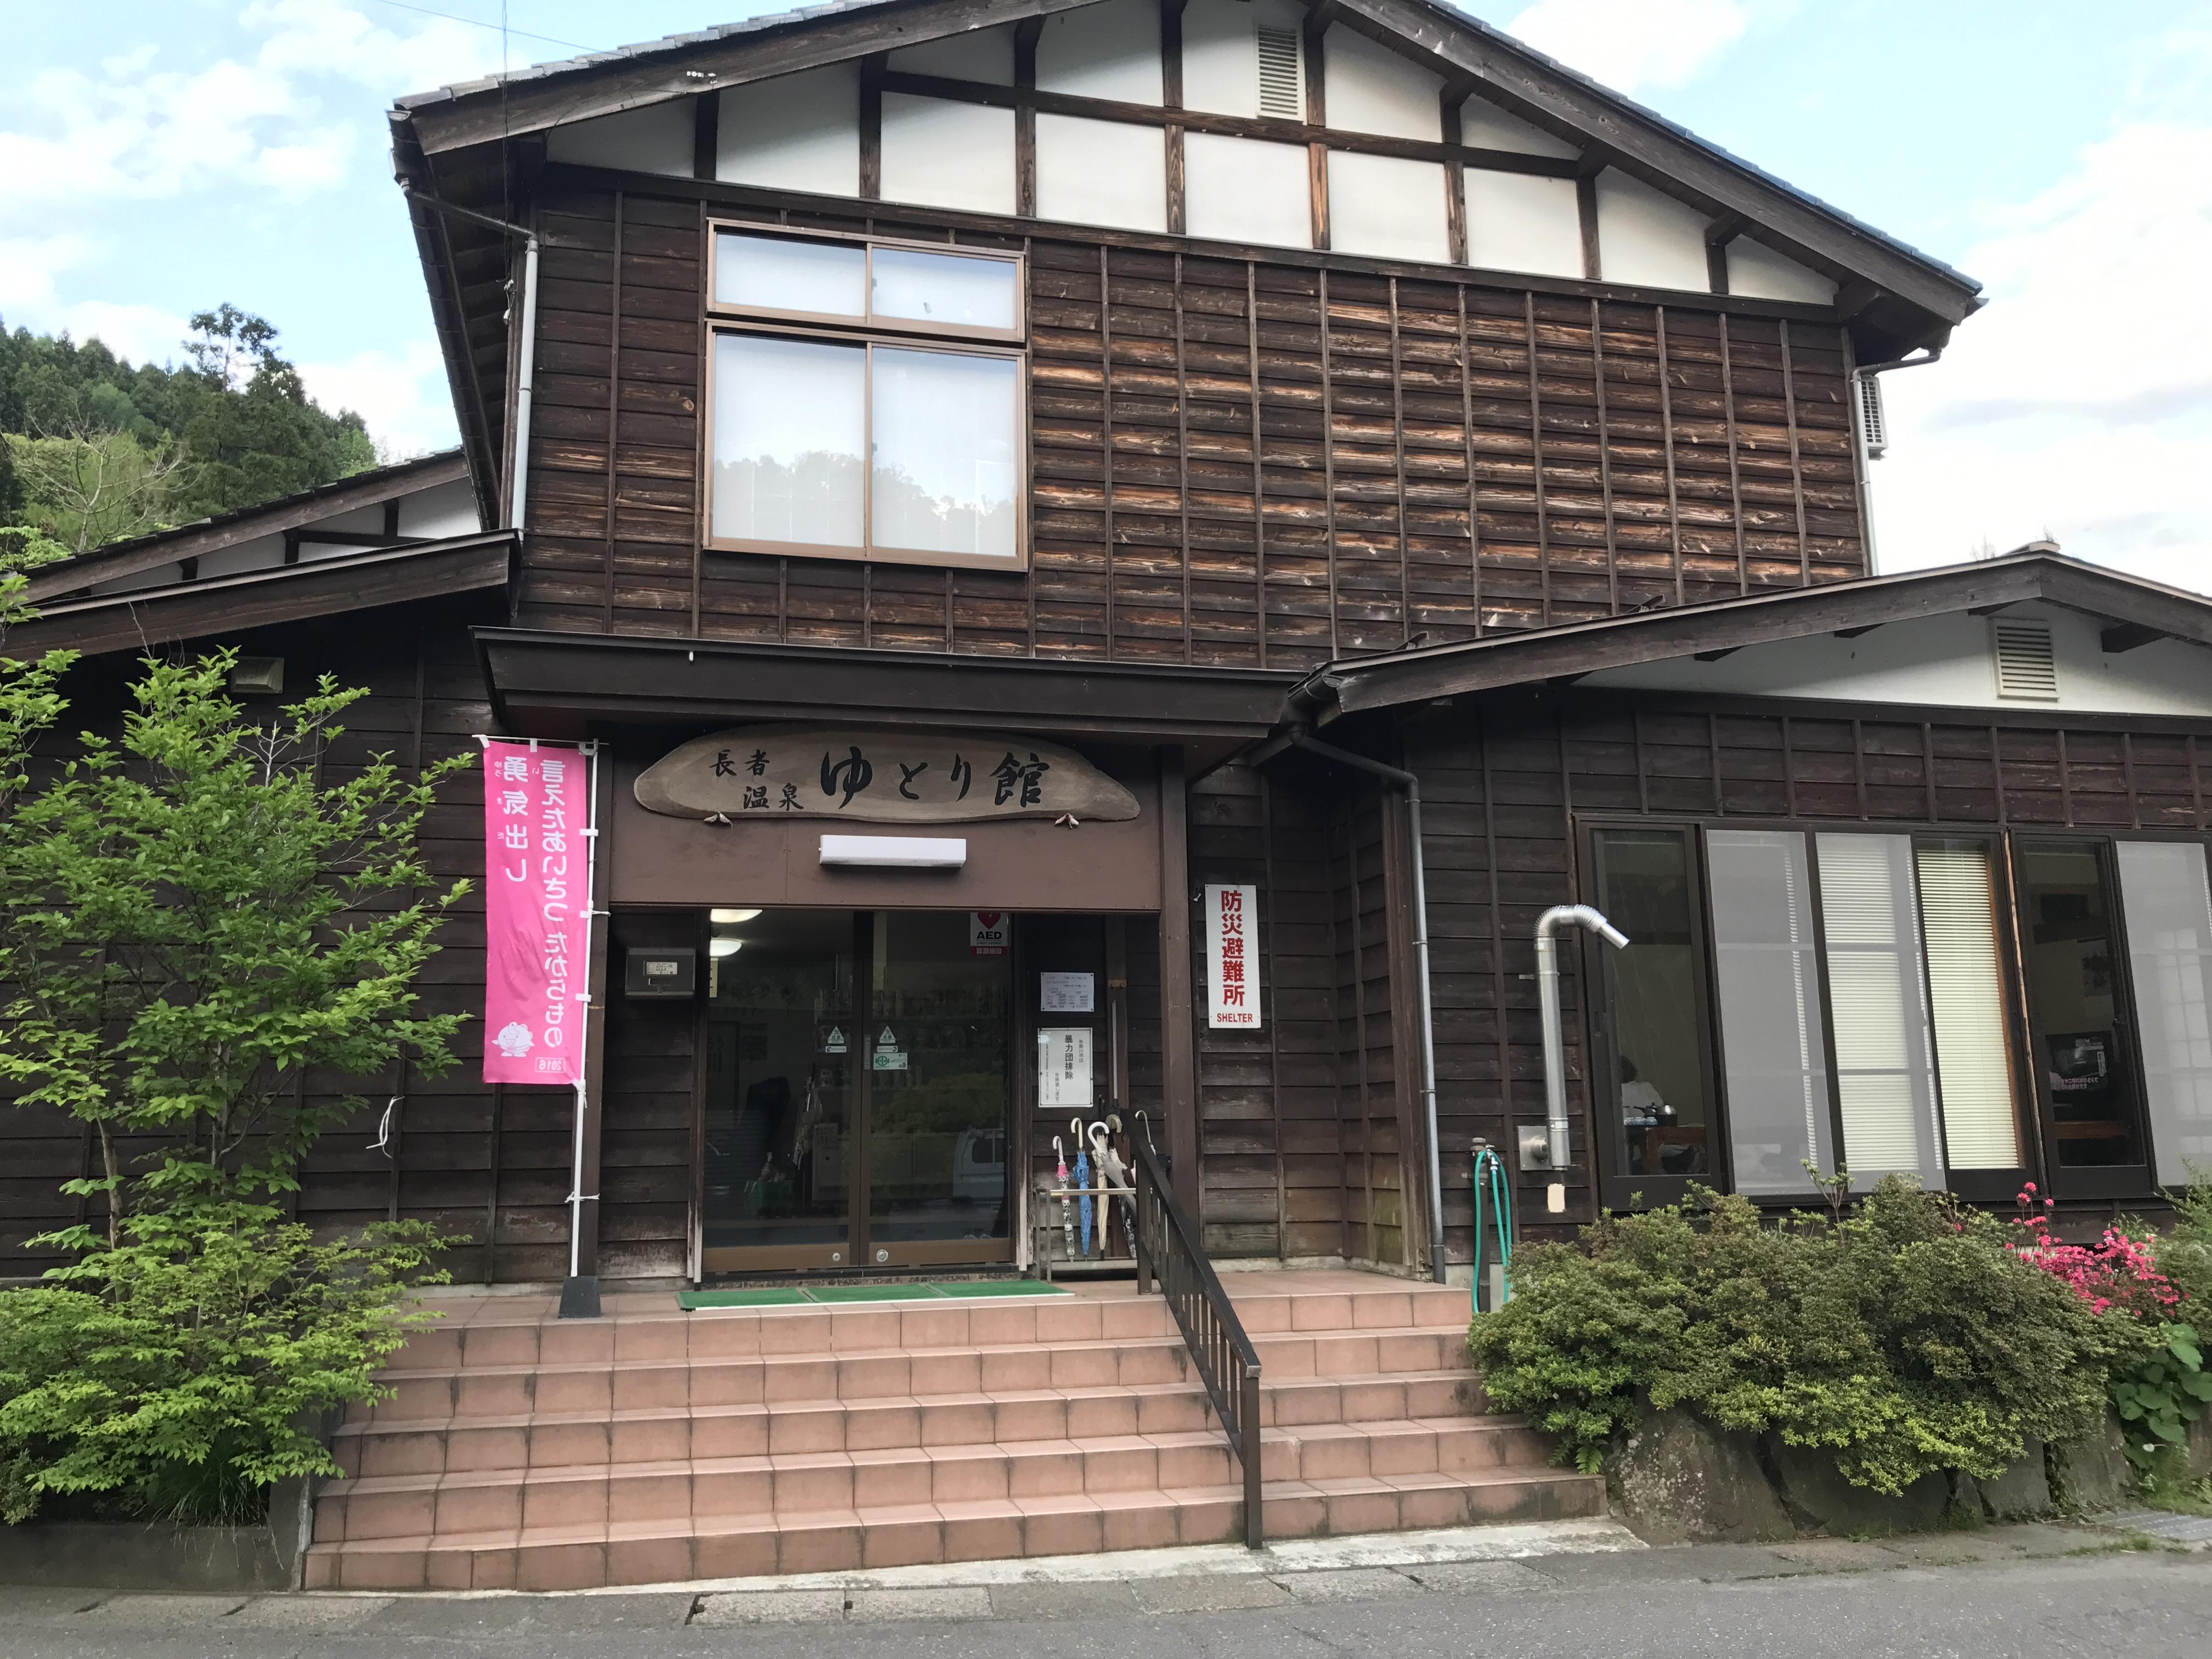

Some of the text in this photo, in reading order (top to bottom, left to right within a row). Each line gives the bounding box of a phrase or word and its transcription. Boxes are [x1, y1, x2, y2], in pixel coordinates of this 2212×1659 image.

[709, 749, 770, 777] 長者
[820, 746, 1050, 810] ゆとり館
[743, 782, 804, 811] 温泉
[977, 931, 1002, 939] AED
[1221, 890, 1245, 1007] 防災避難所
[1217, 1013, 1253, 1023] SHELTER
[1064, 1035, 1074, 1080] 暴力団排除
